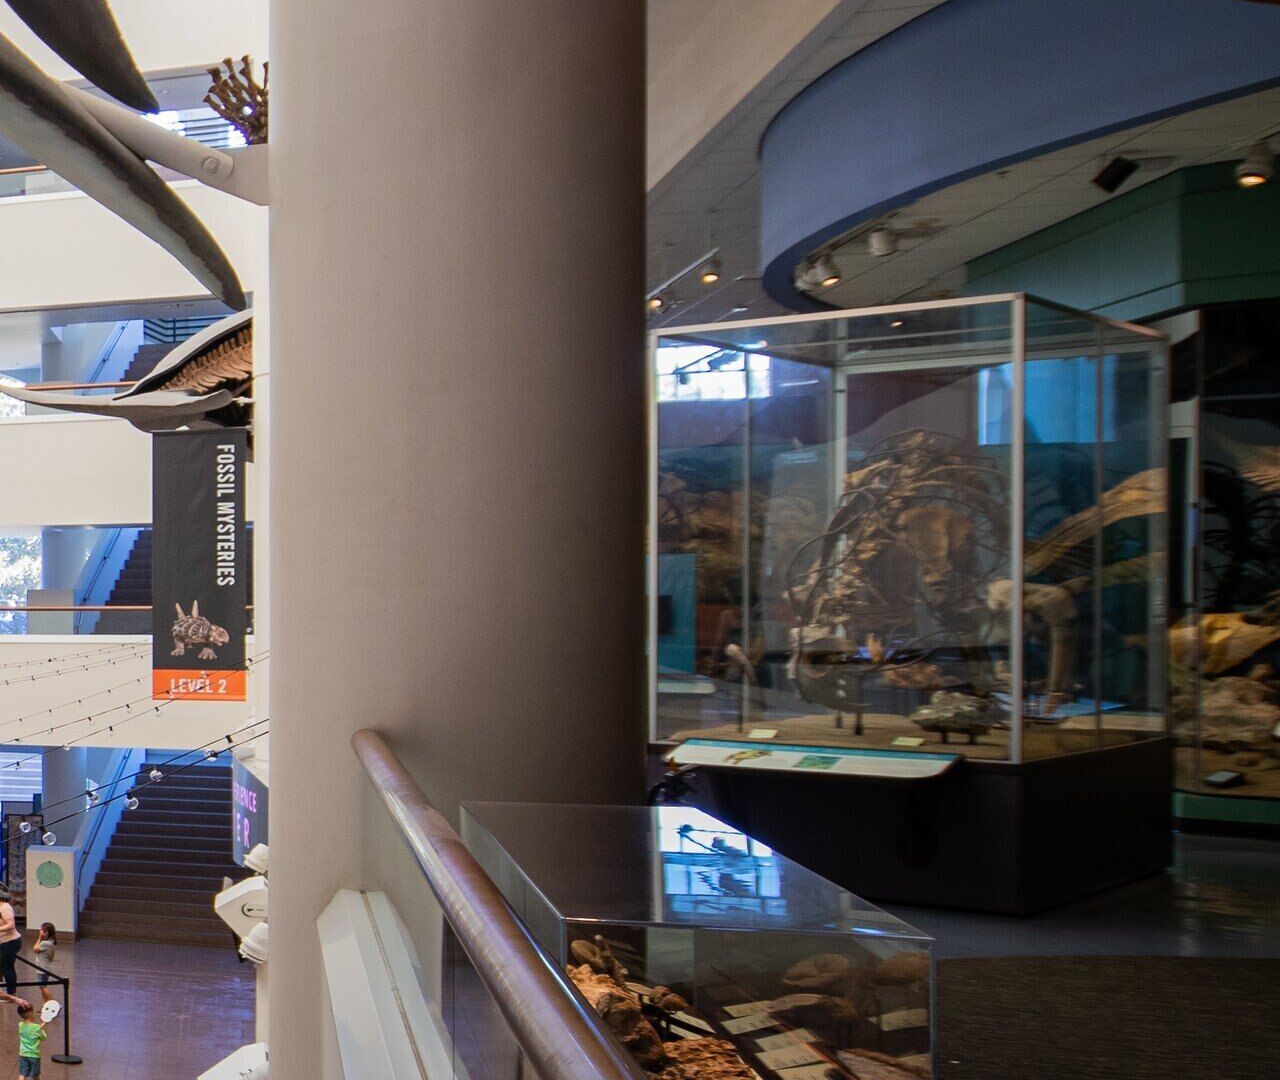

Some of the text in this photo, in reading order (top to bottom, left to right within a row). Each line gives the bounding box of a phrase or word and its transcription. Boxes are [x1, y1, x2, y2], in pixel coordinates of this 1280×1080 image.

[217, 444, 235, 586] FOSSIL MYSTERIES
[171, 678, 227, 694] LEVEL 2
